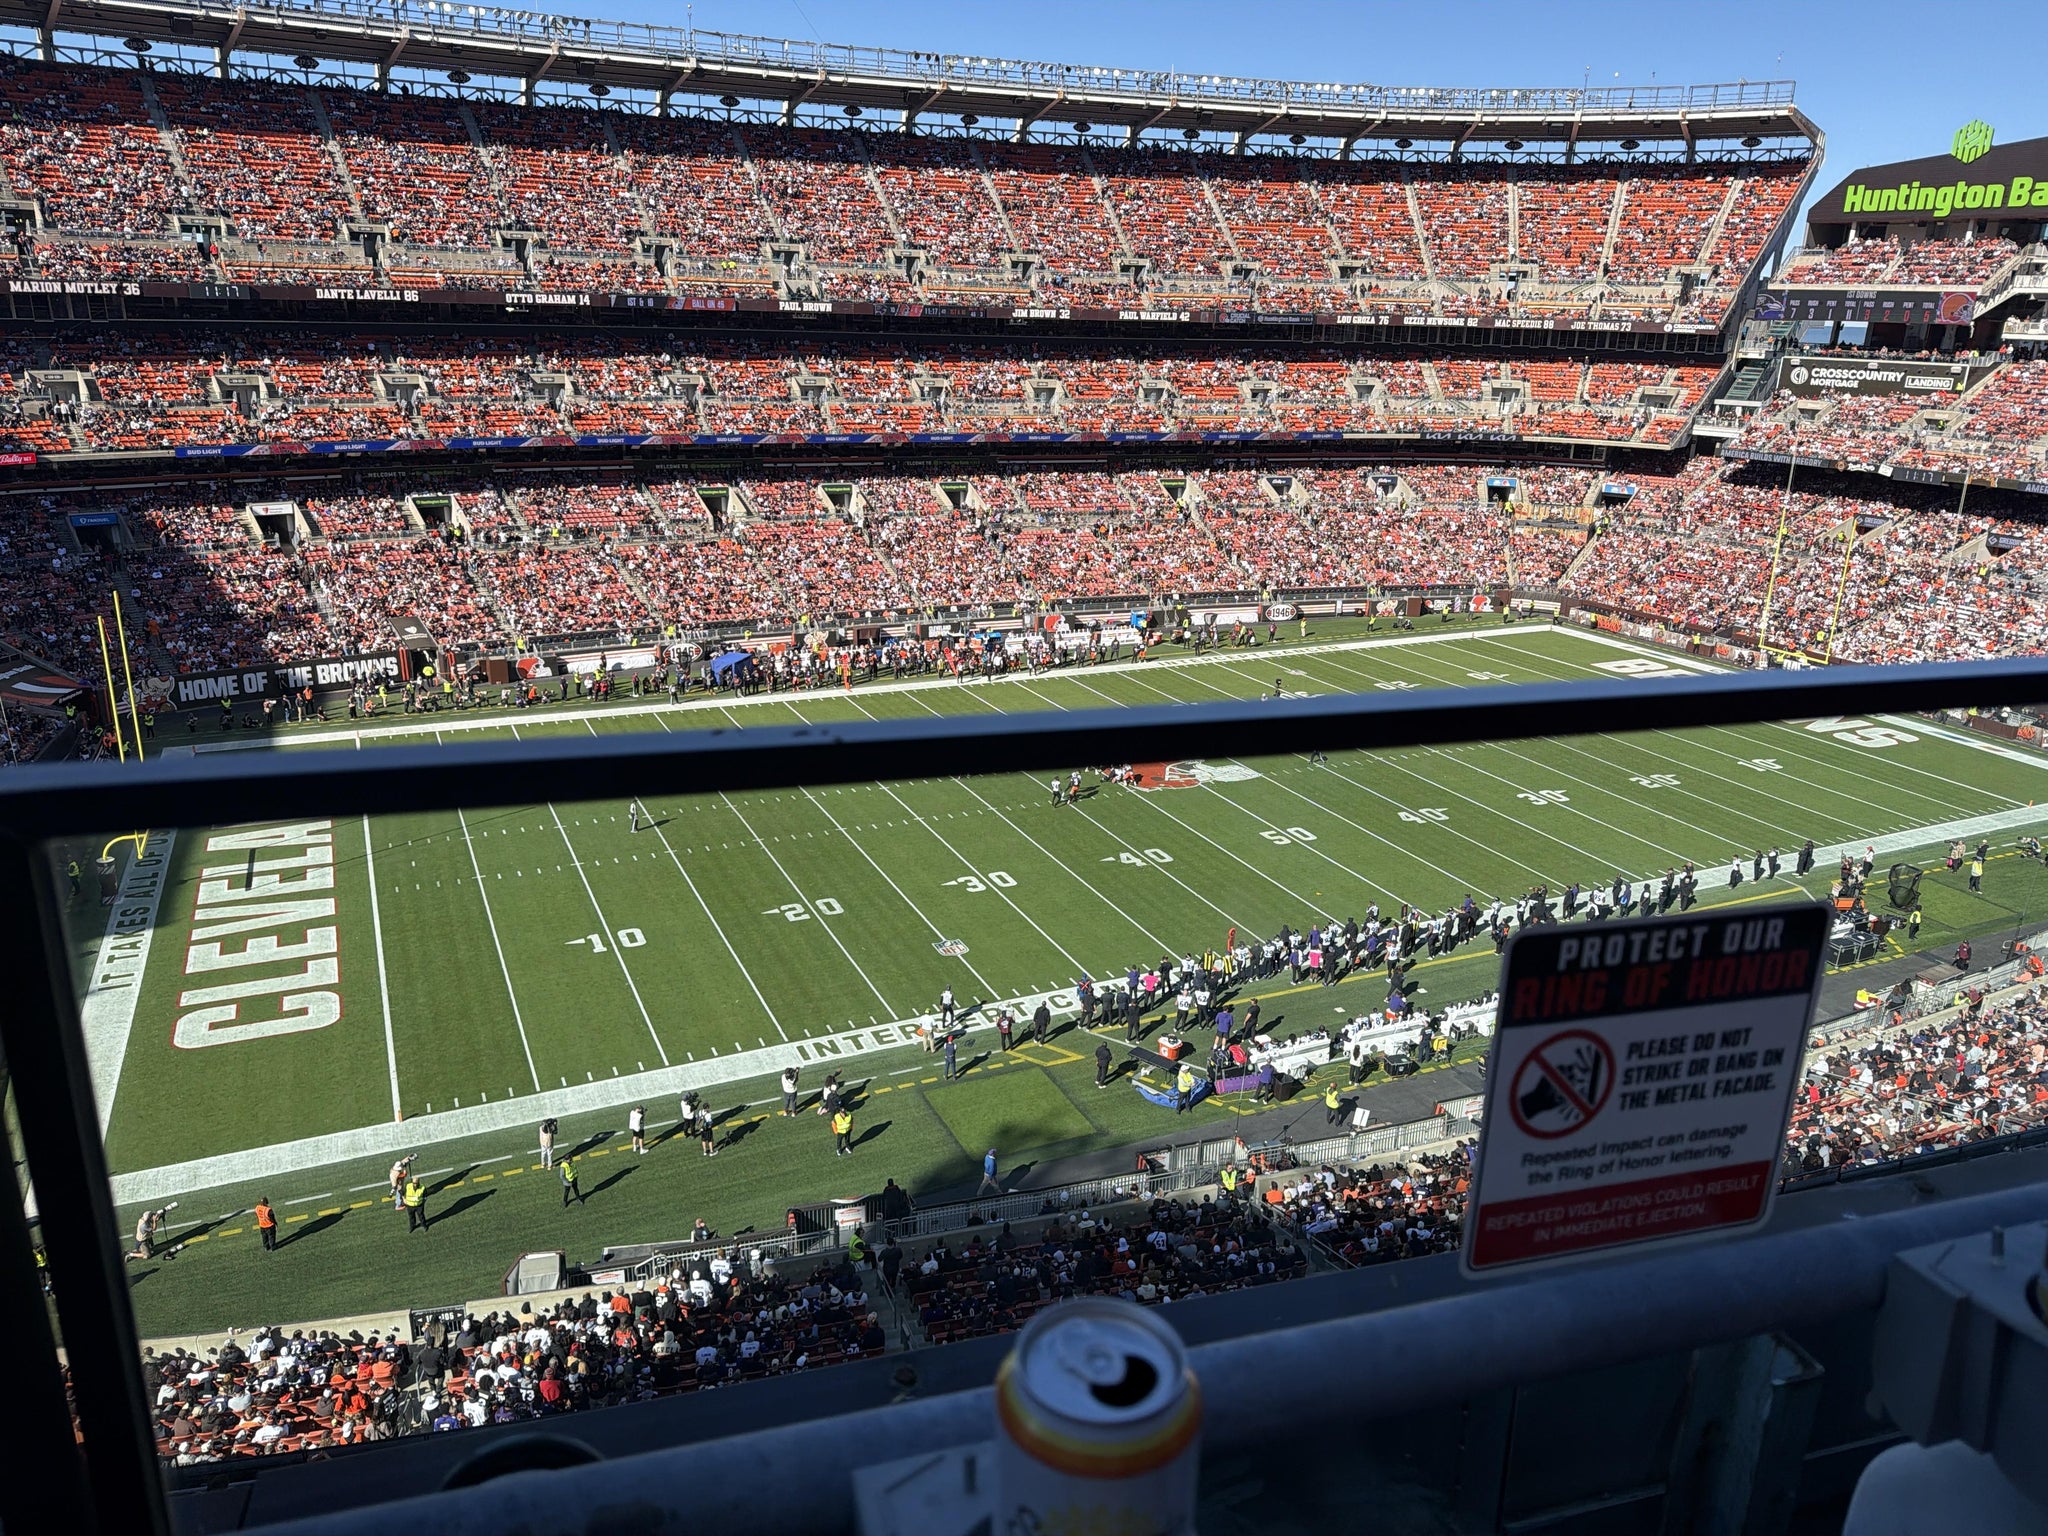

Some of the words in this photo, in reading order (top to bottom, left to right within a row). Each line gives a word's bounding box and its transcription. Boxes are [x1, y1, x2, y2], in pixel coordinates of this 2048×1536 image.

[1843, 180, 2005, 217] Huntington
[9, 280, 62, 293] MARION
[64, 282, 118, 295] MOTLEY
[122, 283, 141, 296] 36
[205, 286, 240, 297] 11:17
[316, 288, 354, 300] DANTE
[355, 289, 402, 301] LAVELLI
[404, 290, 420, 302] 86
[505, 293, 533, 304] OTTO
[535, 294, 577, 305] GRAHAM
[579, 294, 591, 306] 14
[779, 301, 801, 311] PAUL
[803, 302, 833, 313] BROWN
[1012, 308, 1028, 318] JIM
[1030, 309, 1057, 319] BROWN
[1059, 309, 1071, 320] 32
[1119, 310, 1139, 320] PAUL
[1140, 311, 1178, 322] WARFIELD
[1179, 312, 1190, 322] 42
[1337, 315, 1351, 325] LOU
[1352, 316, 1376, 325] GROZA
[1378, 316, 1390, 326] 76
[1403, 317, 1425, 325] OZZIE
[1426, 317, 1465, 327] NEWSOME
[1467, 318, 1478, 327] 82
[1790, 308, 1797, 319] 7
[1808, 309, 1815, 319] 3
[1845, 309, 1853, 320] 11
[1884, 310, 1890, 321] 2
[1903, 310, 1910, 322] 0
[1494, 319, 1511, 328] MAC
[1511, 320, 1542, 329] SPEEDIE
[1571, 321, 1585, 330] JOE
[1586, 322, 1619, 332] THOMAS
[1620, 323, 1632, 332] 73
[1810, 378, 1859, 388] MORTGAGE
[1811, 367, 1905, 383] CROSSCOUNTRY
[1907, 378, 1951, 389] LANDING
[1720, 449, 1749, 460] AMERICA
[1750, 452, 1773, 462] BUILDS
[1773, 454, 1791, 464] WITH
[1271, 607, 1290, 618] 1946
[1268, 645, 1341, 658] CANCER
[178, 674, 240, 702] HOME
[243, 671, 269, 693] OF
[275, 666, 314, 689] THE
[317, 656, 400, 685] BROWNS
[1516, 789, 1564, 806] 30
[1396, 807, 1441, 825] 40
[1259, 826, 1318, 846] 50
[1119, 848, 1174, 867] 40
[124, 871, 159, 899] ALL
[957, 871, 1018, 894] 30
[780, 897, 845, 922] 20
[106, 906, 151, 965] TAKES
[585, 927, 648, 954] 10
[942, 945, 965, 955] NFL
[1556, 925, 1710, 973] PROTECT
[1722, 917, 1786, 954] OUR
[98, 973, 135, 992] IT
[1511, 969, 1608, 1021] RING
[1624, 964, 1674, 1008] OF
[1686, 947, 1811, 1000] HONOR
[1626, 1035, 1686, 1061] PLEASE
[1693, 1033, 1714, 1054] DO
[1720, 1026, 1754, 1048] NOT
[1620, 1060, 1683, 1087] STRIKE
[1687, 1056, 1711, 1078] OR
[1713, 1051, 1758, 1074] BANG
[1761, 1046, 1786, 1067] ON
[1618, 1090, 1650, 1112] THE
[1655, 1082, 1709, 1108] METAL
[1712, 1073, 1778, 1102] FACADE.
[1520, 1141, 1598, 1171] Repeated
[1601, 1136, 1654, 1161] impact
[1657, 1133, 1686, 1148] can
[1691, 1121, 1749, 1146] damage
[1527, 1167, 1554, 1186] the
[1556, 1160, 1594, 1184] Ring
[1598, 1159, 1615, 1176] of
[1618, 1152, 1667, 1174] Honor
[1669, 1143, 1735, 1168] lettering.
[1485, 1207, 1566, 1232] REPEATED
[1567, 1195, 1652, 1221] VIOLATIONS
[1656, 1185, 1704, 1208] COULD
[1706, 1173, 1761, 1199] RESULT
[1533, 1226, 1551, 1243] IN
[1552, 1214, 1632, 1241] IMMEDIATE
